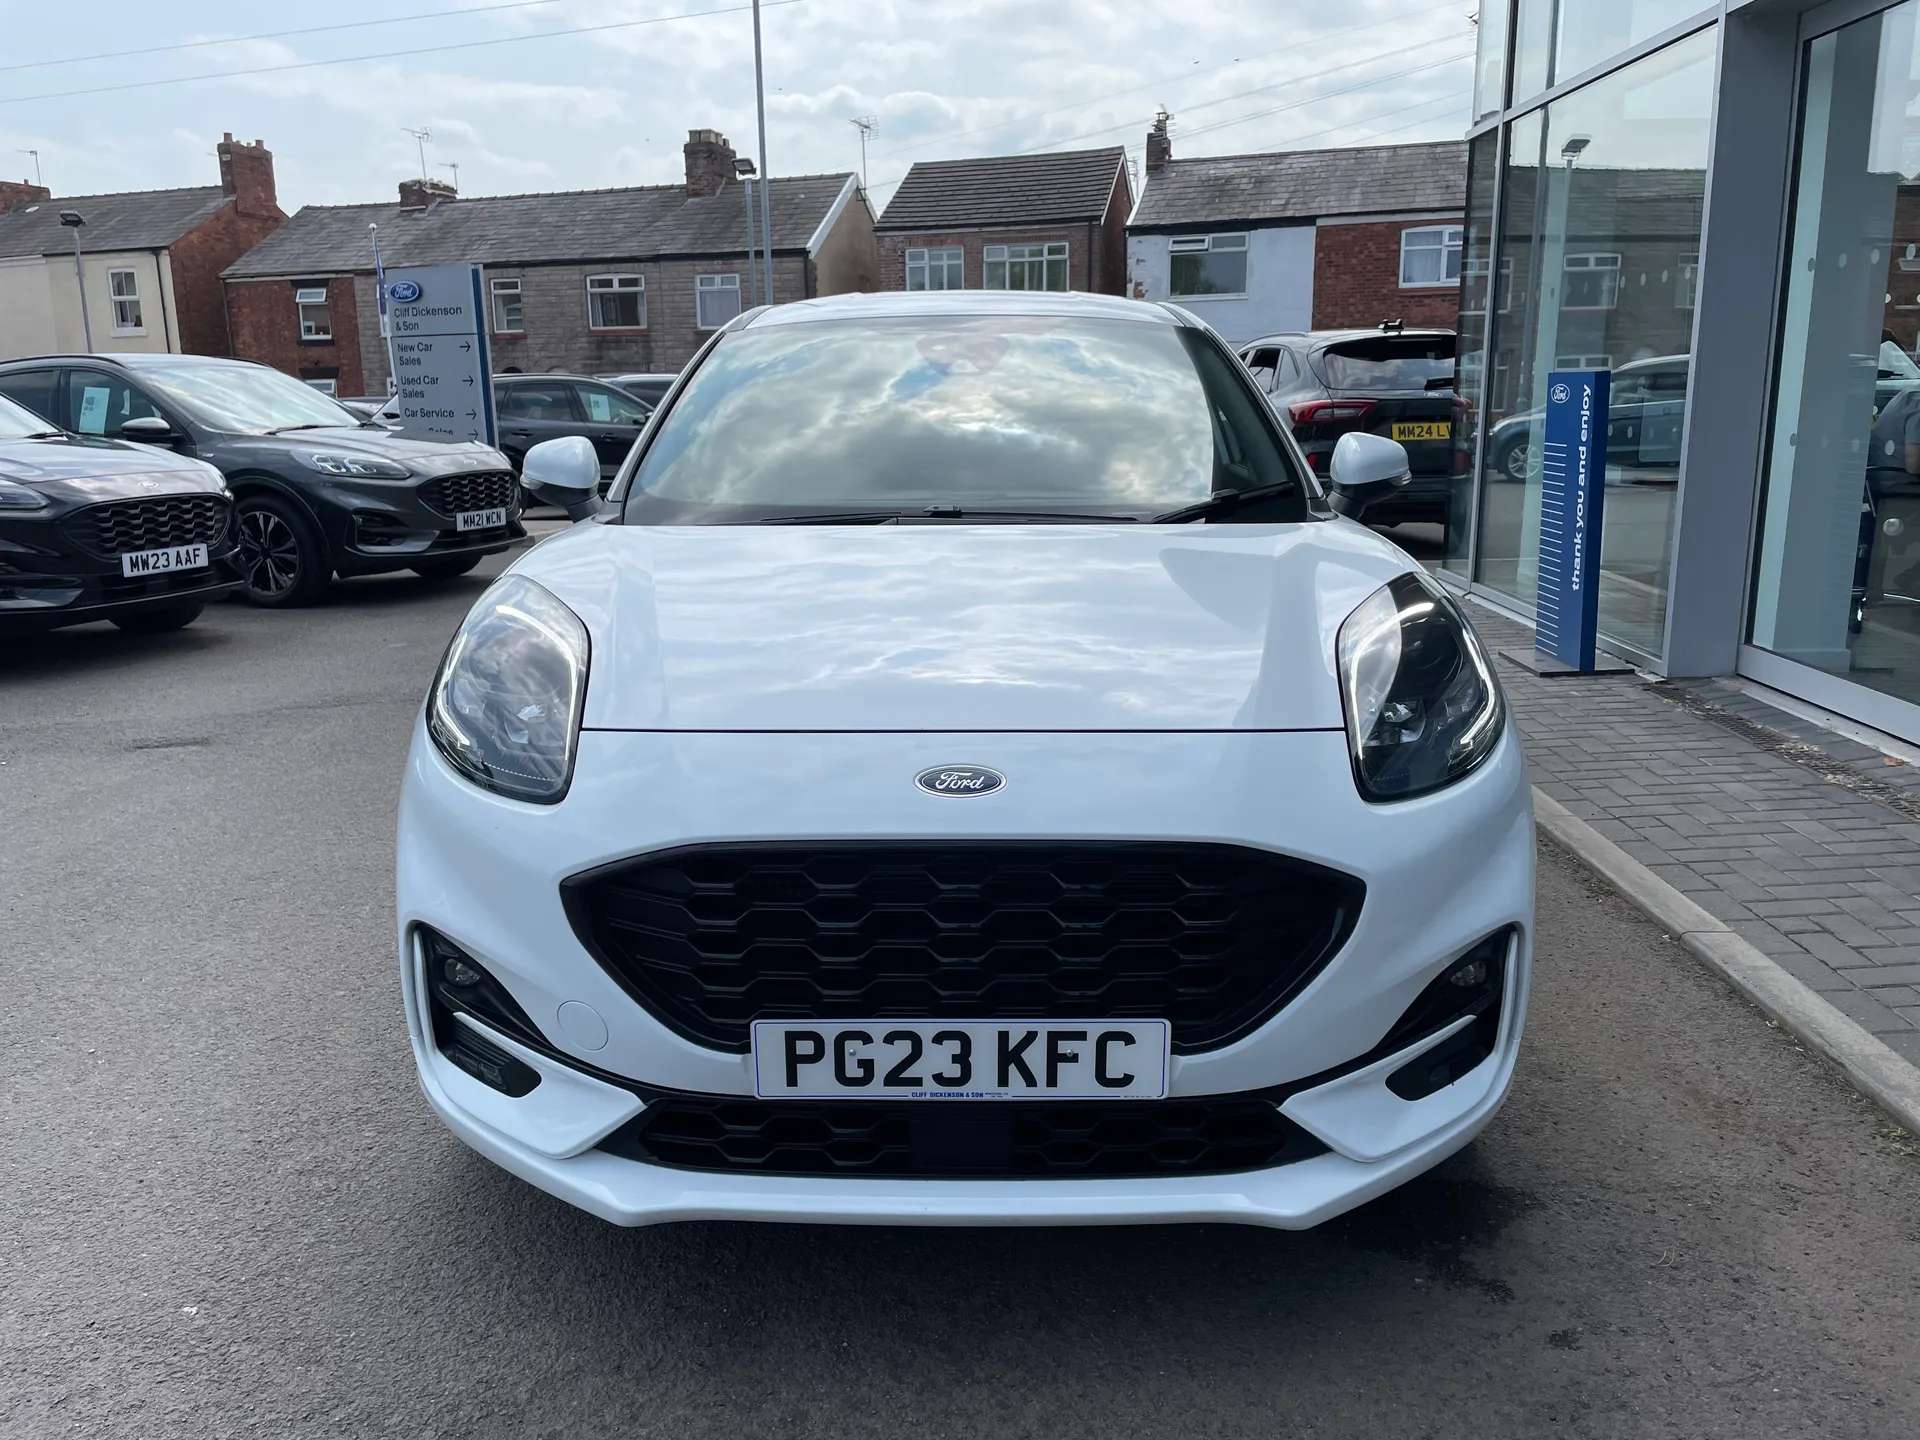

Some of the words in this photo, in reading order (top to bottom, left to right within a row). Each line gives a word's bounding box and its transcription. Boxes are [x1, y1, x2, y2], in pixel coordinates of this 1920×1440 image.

[394, 284, 413, 298] Ford
[394, 308, 410, 318] Cliff
[411, 305, 463, 317] Dickenson
[395, 323, 402, 331] &
[402, 322, 420, 331] Son
[397, 343, 415, 353] New
[416, 342, 433, 352] Car
[399, 355, 422, 366] Sales
[400, 375, 421, 386] Used
[422, 375, 440, 385] Car
[402, 388, 425, 399] Sales
[1553, 386, 1568, 401] Ford
[404, 407, 418, 418] Car
[419, 407, 455, 418] Service
[1580, 383, 1592, 443] enjoy
[1578, 445, 1587, 487] and
[1575, 490, 1585, 528] you
[485, 510, 502, 526] WCN
[129, 551, 171, 573] MW23
[175, 547, 201, 567] AAF
[1571, 531, 1583, 592] thank
[935, 771, 985, 789] Ford
[783, 1029, 973, 1089] PG23
[996, 1029, 1138, 1089] KFC
